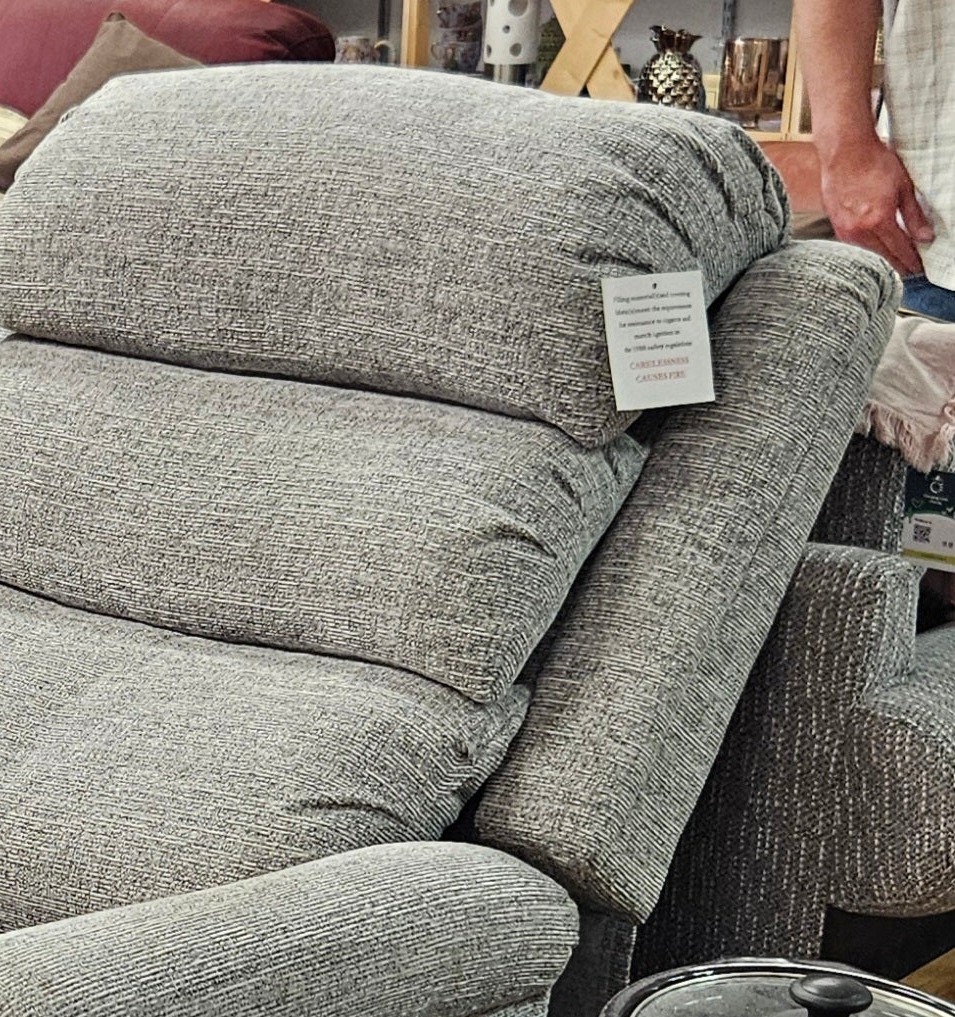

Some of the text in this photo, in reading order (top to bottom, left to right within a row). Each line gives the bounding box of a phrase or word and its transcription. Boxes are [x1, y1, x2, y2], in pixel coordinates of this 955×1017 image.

[630, 356, 690, 370] CARELESSNESS
[636, 370, 687, 383] CAUSES FIRE
